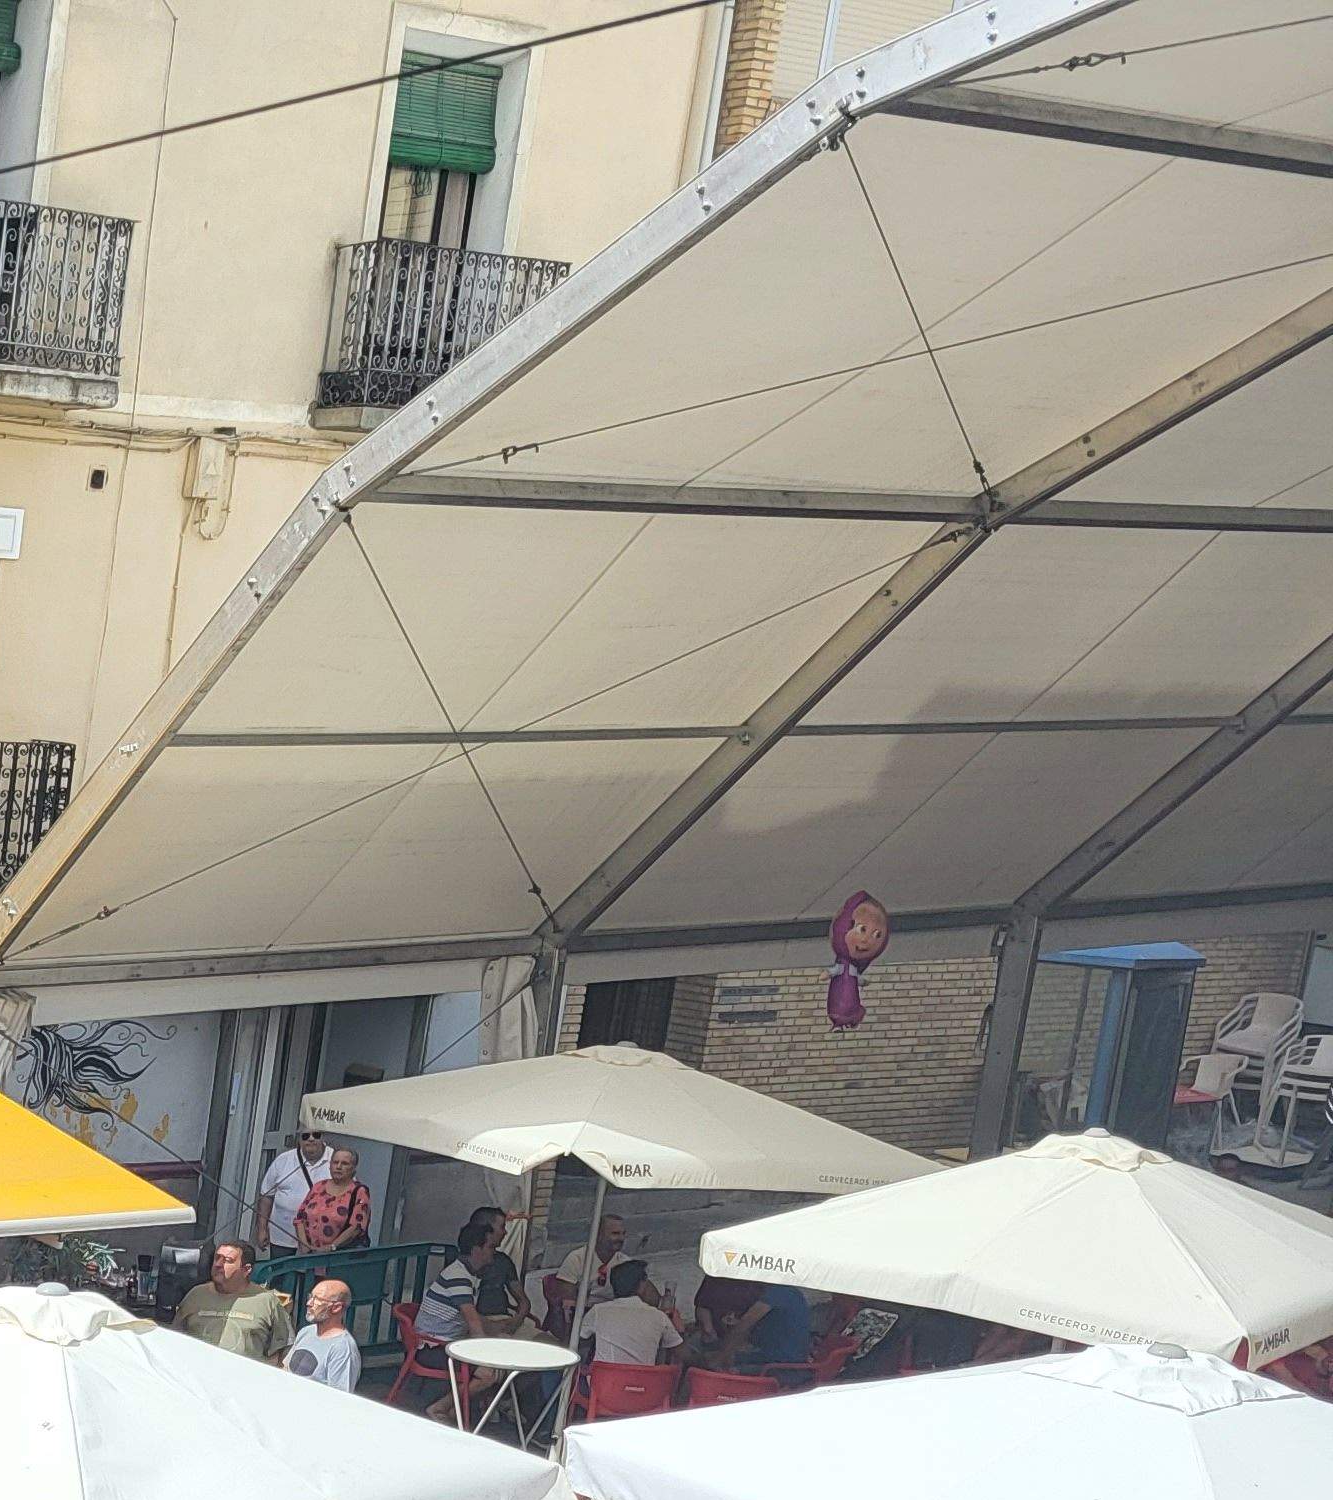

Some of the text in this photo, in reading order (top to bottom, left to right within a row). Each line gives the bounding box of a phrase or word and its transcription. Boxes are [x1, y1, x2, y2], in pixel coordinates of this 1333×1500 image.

[313, 1107, 346, 1124] AMBAR
[456, 1141, 496, 1158] CERVECEROS
[612, 1163, 653, 1178] MBAR
[818, 1174, 870, 1186] CERVECEROS
[737, 1253, 796, 1274] AMBAR
[1019, 1308, 1097, 1334] CERVECEROS
[1261, 1328, 1290, 1354] AMBAR
